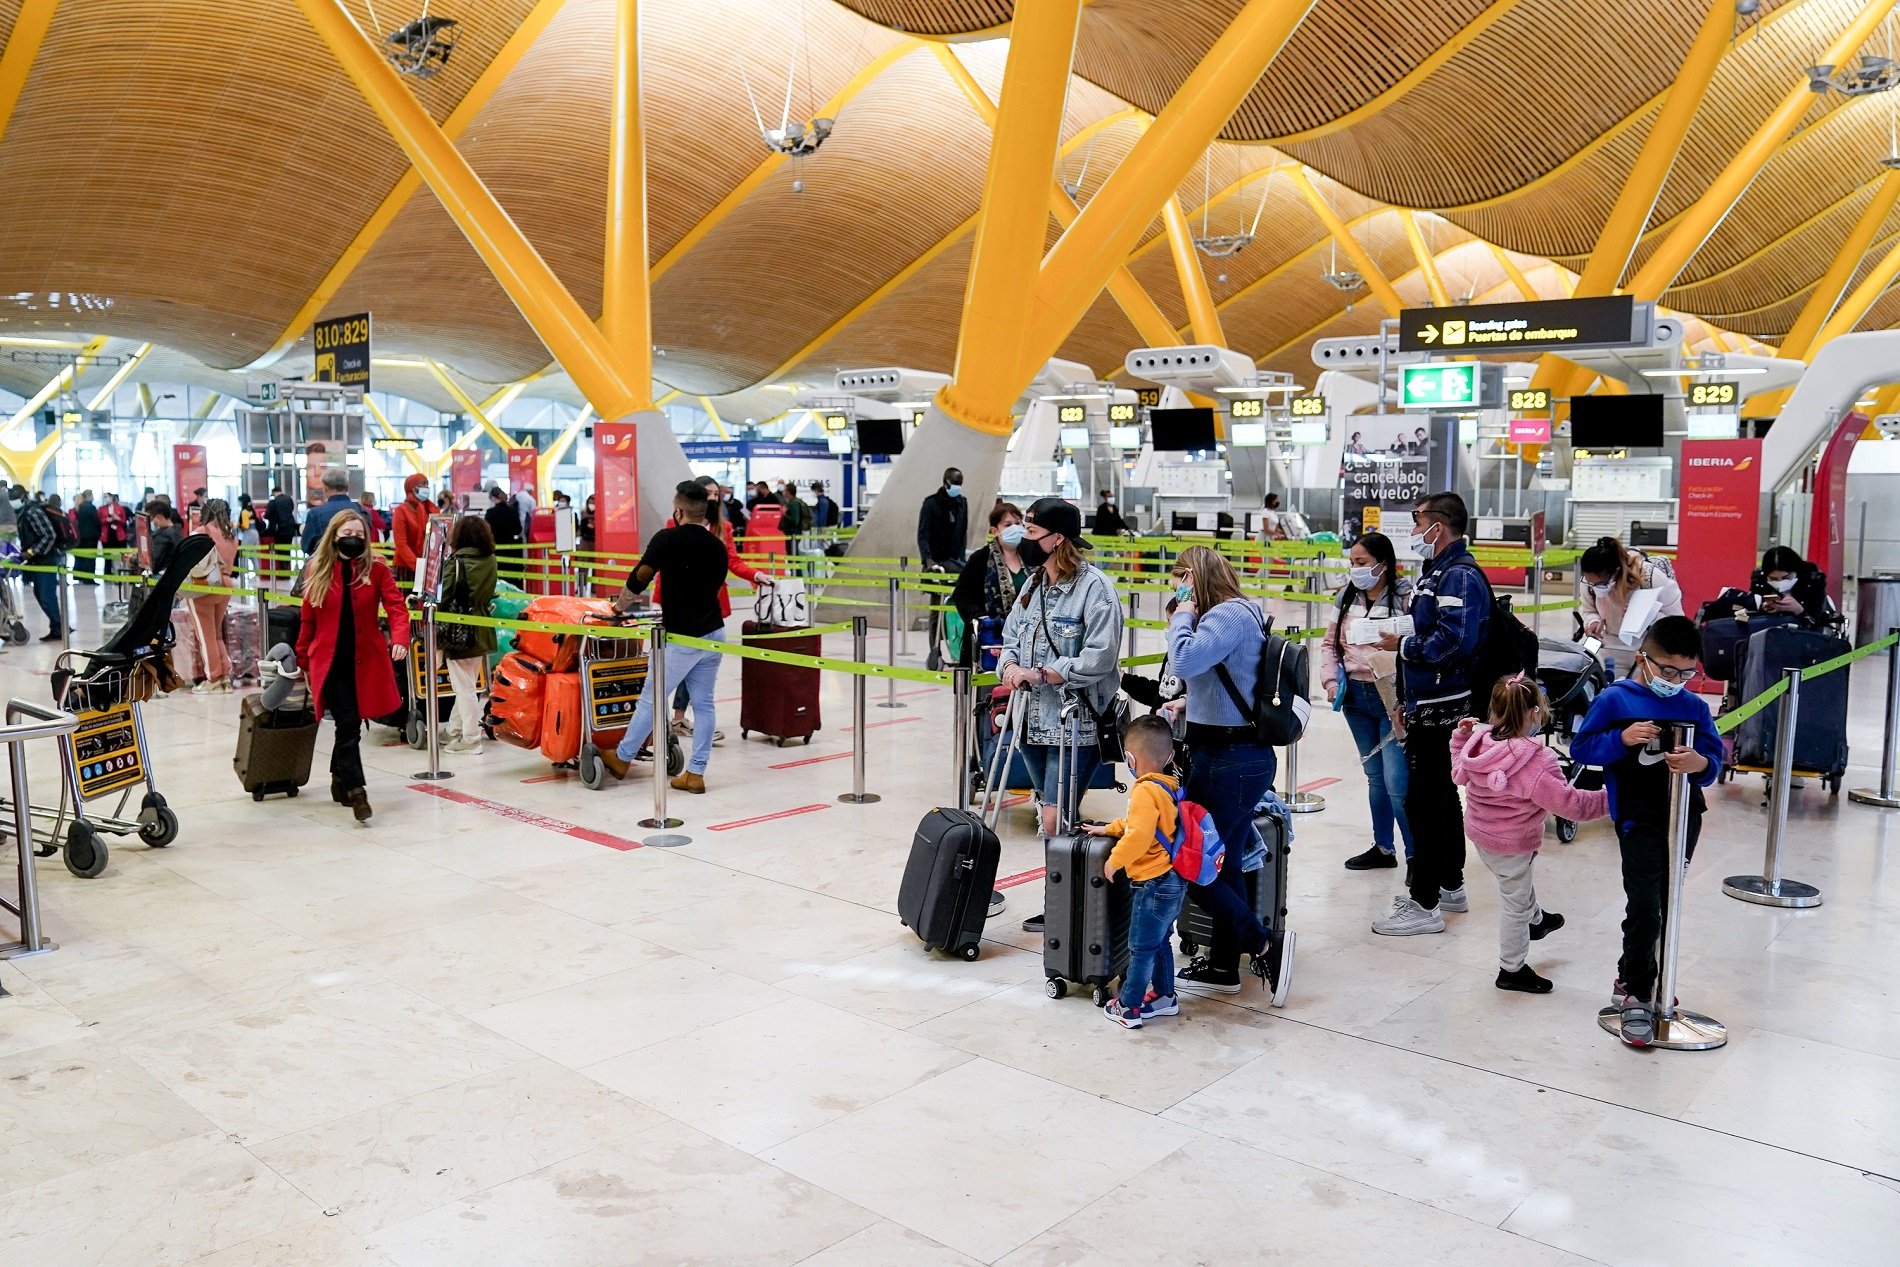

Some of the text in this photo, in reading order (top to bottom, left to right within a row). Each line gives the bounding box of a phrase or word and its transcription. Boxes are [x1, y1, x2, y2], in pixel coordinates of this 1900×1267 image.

[1468, 328, 1578, 342] Puertas de embarque
[1138, 391, 1158, 405] 59
[1511, 391, 1547, 409] 828
[1692, 384, 1734, 404] 829
[1061, 406, 1083, 421] 823
[1110, 405, 1133, 420] 824
[1232, 400, 1260, 416] 825
[1292, 398, 1322, 415] 826
[602, 434, 616, 445] IB
[510, 455, 521, 463] IB
[1688, 457, 1734, 467] IBERIA
[1353, 469, 1425, 484] cancelado
[1353, 485, 1419, 500] el vuelo?
